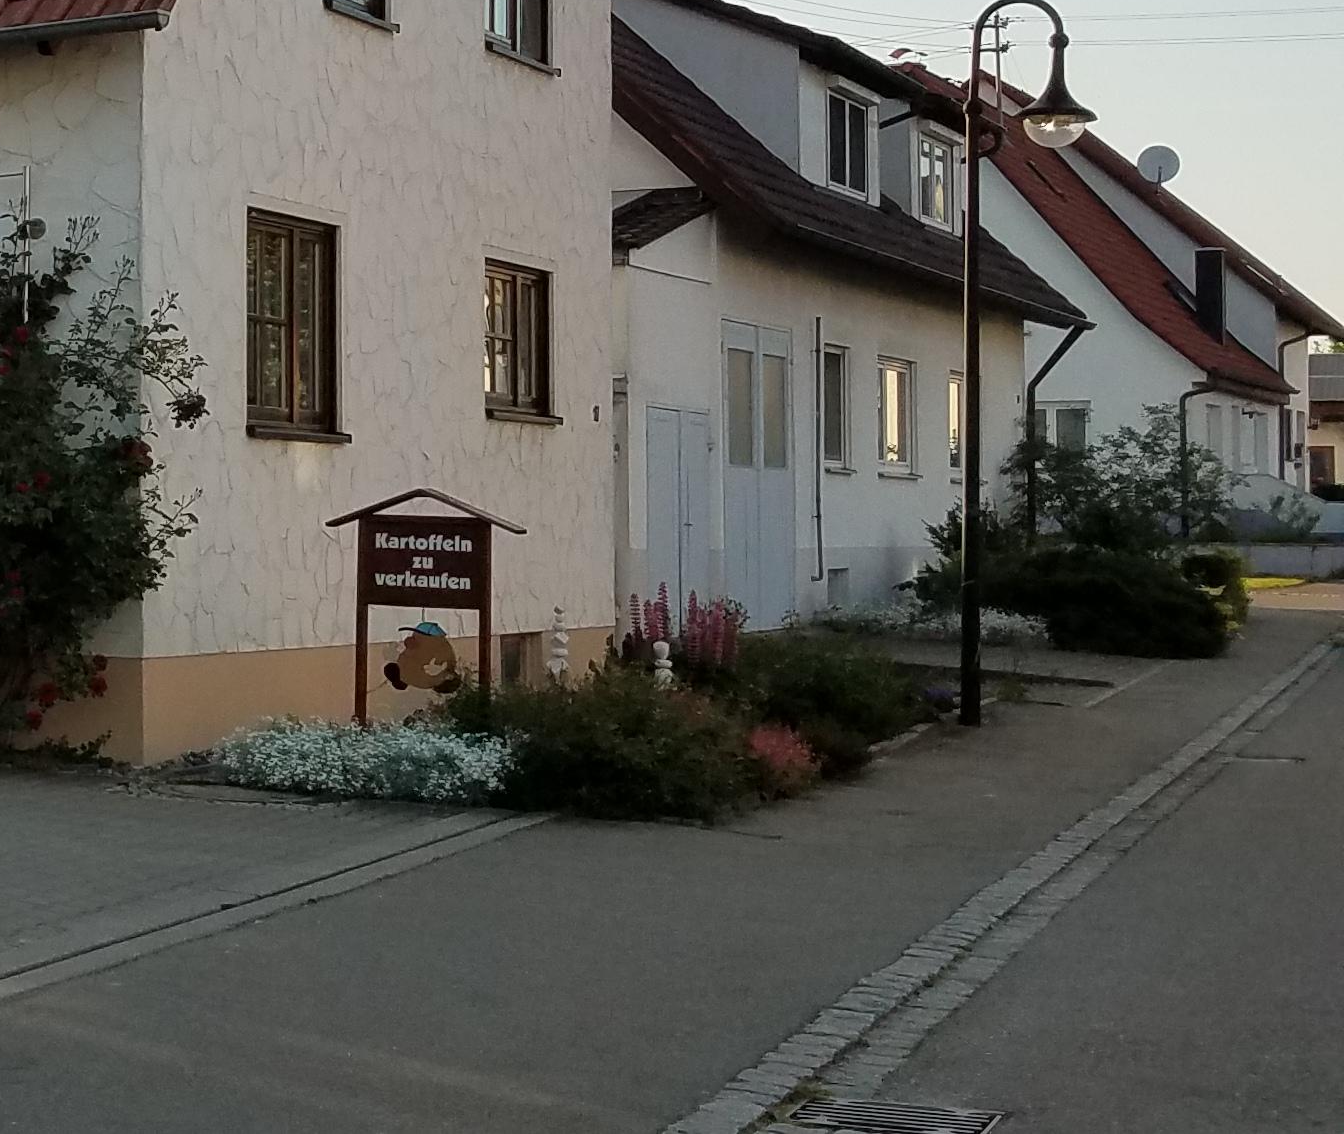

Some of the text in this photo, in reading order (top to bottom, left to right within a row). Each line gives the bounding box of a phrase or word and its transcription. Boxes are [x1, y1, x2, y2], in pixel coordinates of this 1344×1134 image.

[375, 532, 473, 552] Kartoffeln
[412, 556, 433, 569] zu
[374, 570, 471, 590] verkaufen
